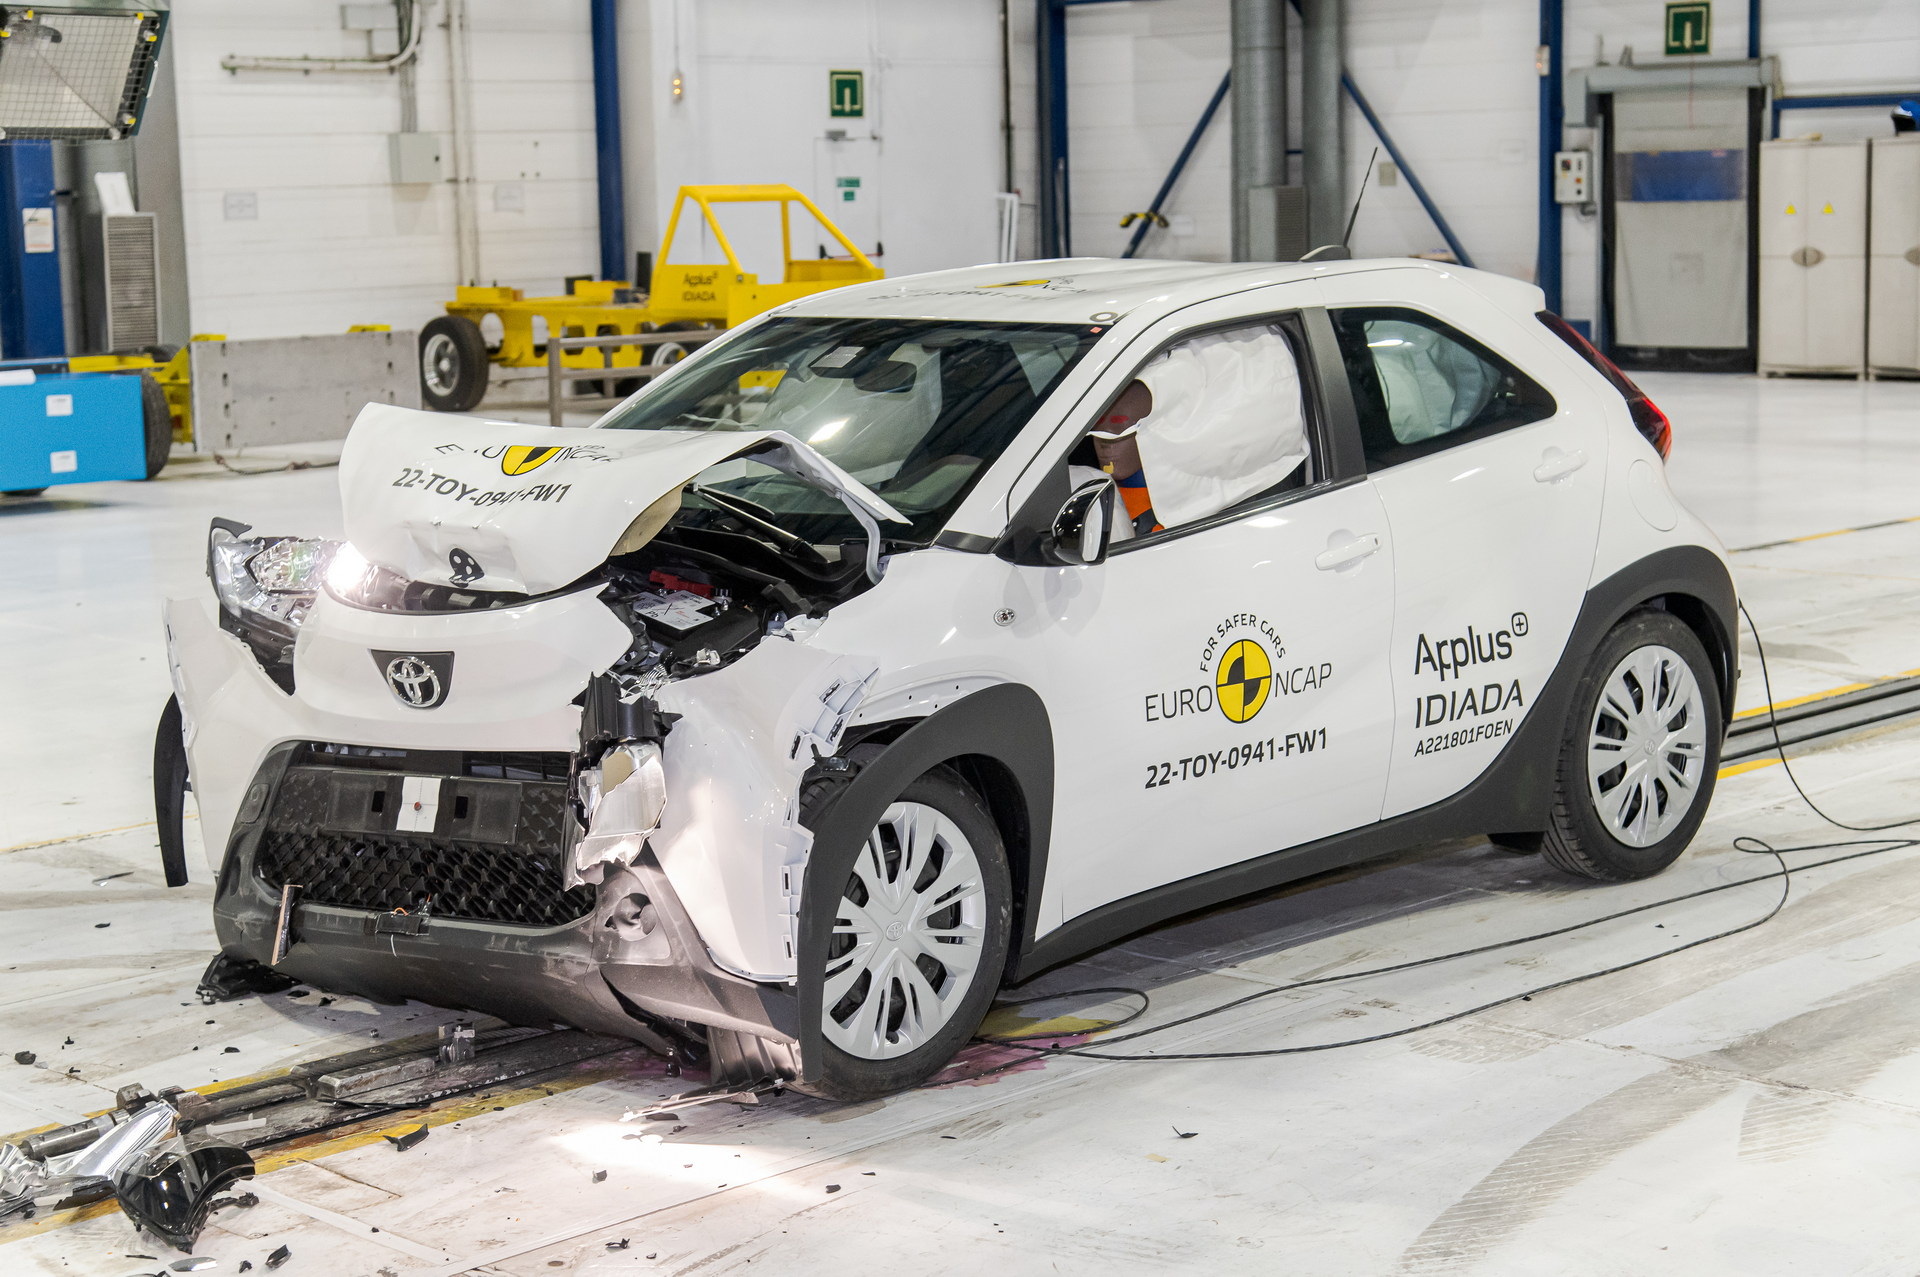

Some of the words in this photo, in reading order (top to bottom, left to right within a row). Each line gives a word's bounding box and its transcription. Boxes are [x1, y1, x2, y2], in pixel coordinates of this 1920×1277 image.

[392, 467, 572, 507] 22-TOY-0941-FW1
[1200, 636, 1218, 672] FOR
[1216, 613, 1257, 638] SAFER
[1260, 620, 1286, 659] CARS
[1145, 685, 1213, 722] EURO
[1274, 662, 1332, 698] NCAP
[1415, 678, 1523, 729] IDIADA
[1145, 726, 1327, 789] 22-TOY-0941-FW1
